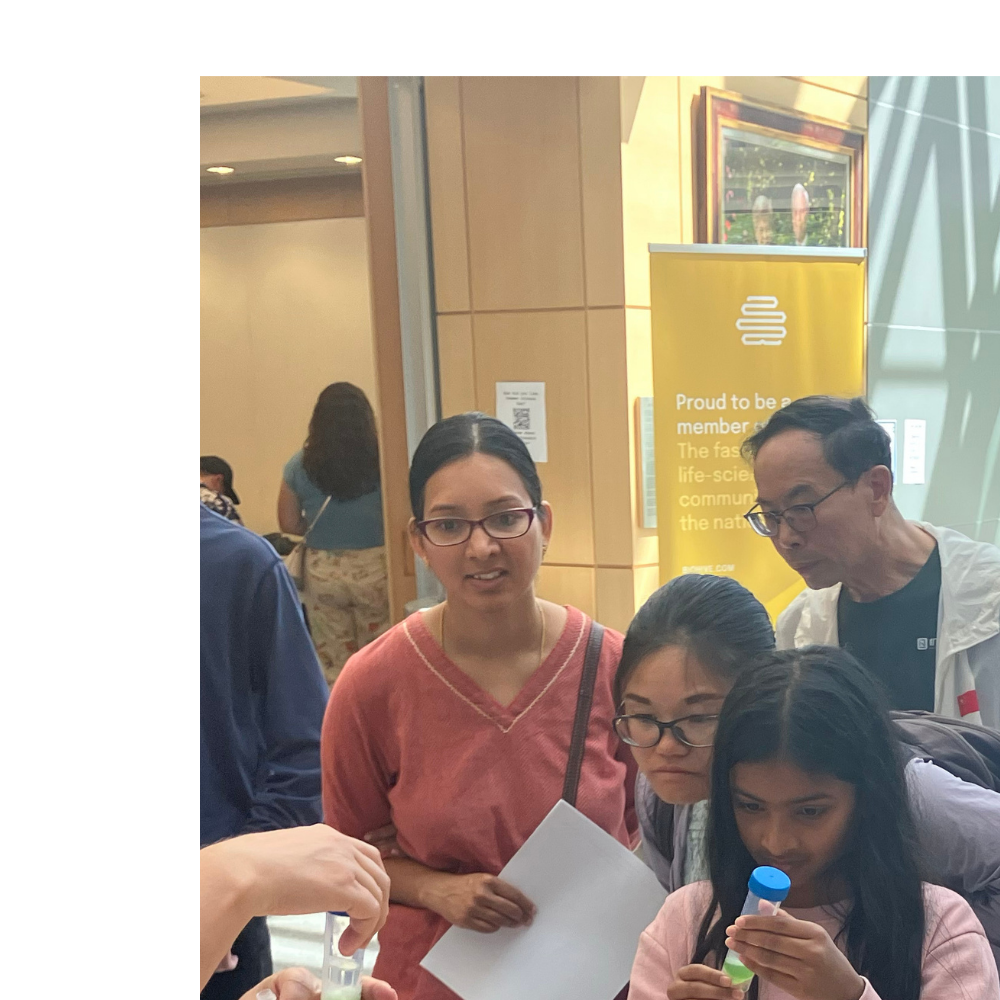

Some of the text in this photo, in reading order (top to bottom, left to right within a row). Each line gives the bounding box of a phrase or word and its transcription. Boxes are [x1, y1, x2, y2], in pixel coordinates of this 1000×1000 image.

[676, 393, 792, 410] Proud to be a
[677, 418, 749, 435] member
[677, 442, 743, 459] The fas
[678, 466, 755, 483] life-scie
[679, 490, 757, 507] communi
[679, 514, 711, 531] the
